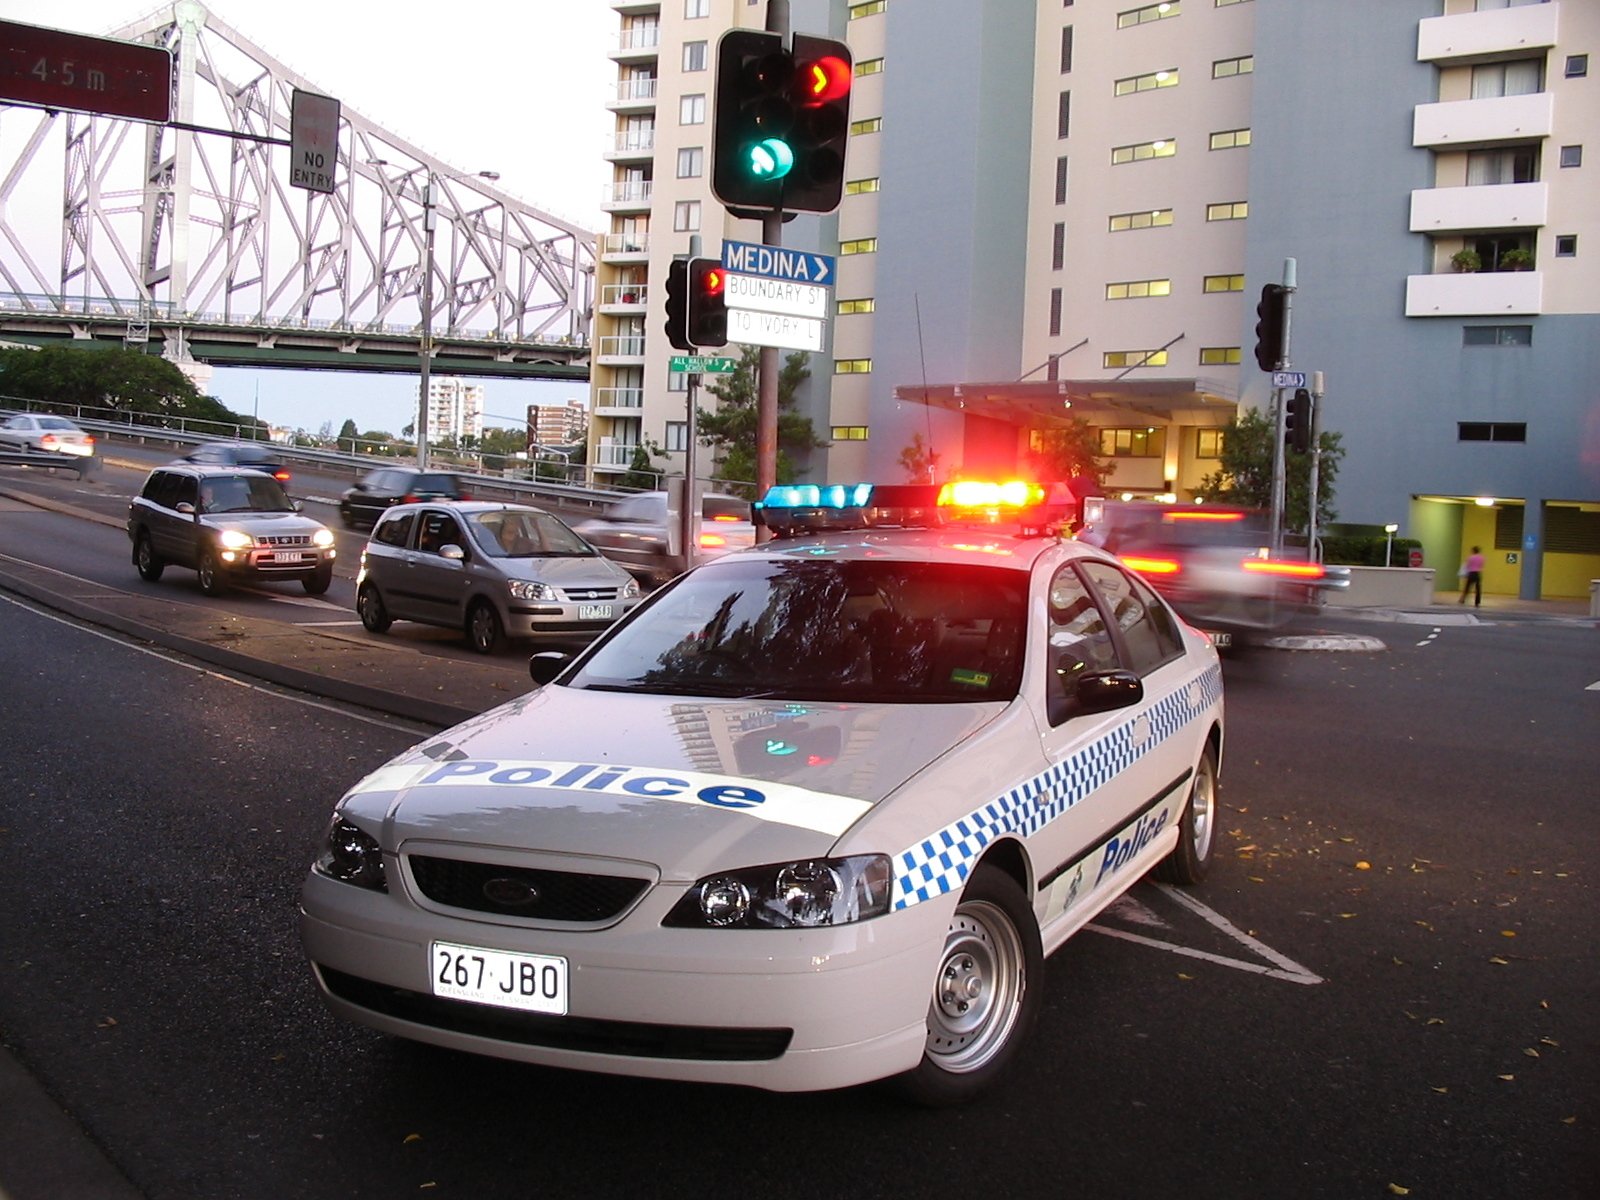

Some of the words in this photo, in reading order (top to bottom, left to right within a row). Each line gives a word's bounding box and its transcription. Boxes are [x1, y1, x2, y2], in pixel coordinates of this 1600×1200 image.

[304, 151, 325, 168] NO
[293, 168, 332, 188] ENTRY
[727, 243, 809, 279] MEDINA
[730, 276, 802, 303] BOUNDARY
[735, 312, 751, 331] TO
[759, 315, 799, 336] IVORY
[1273, 373, 1298, 387] MEDINA
[418, 761, 766, 808] Police
[1094, 808, 1169, 888] Police
[439, 951, 485, 990] 267
[499, 960, 558, 999] JBO
